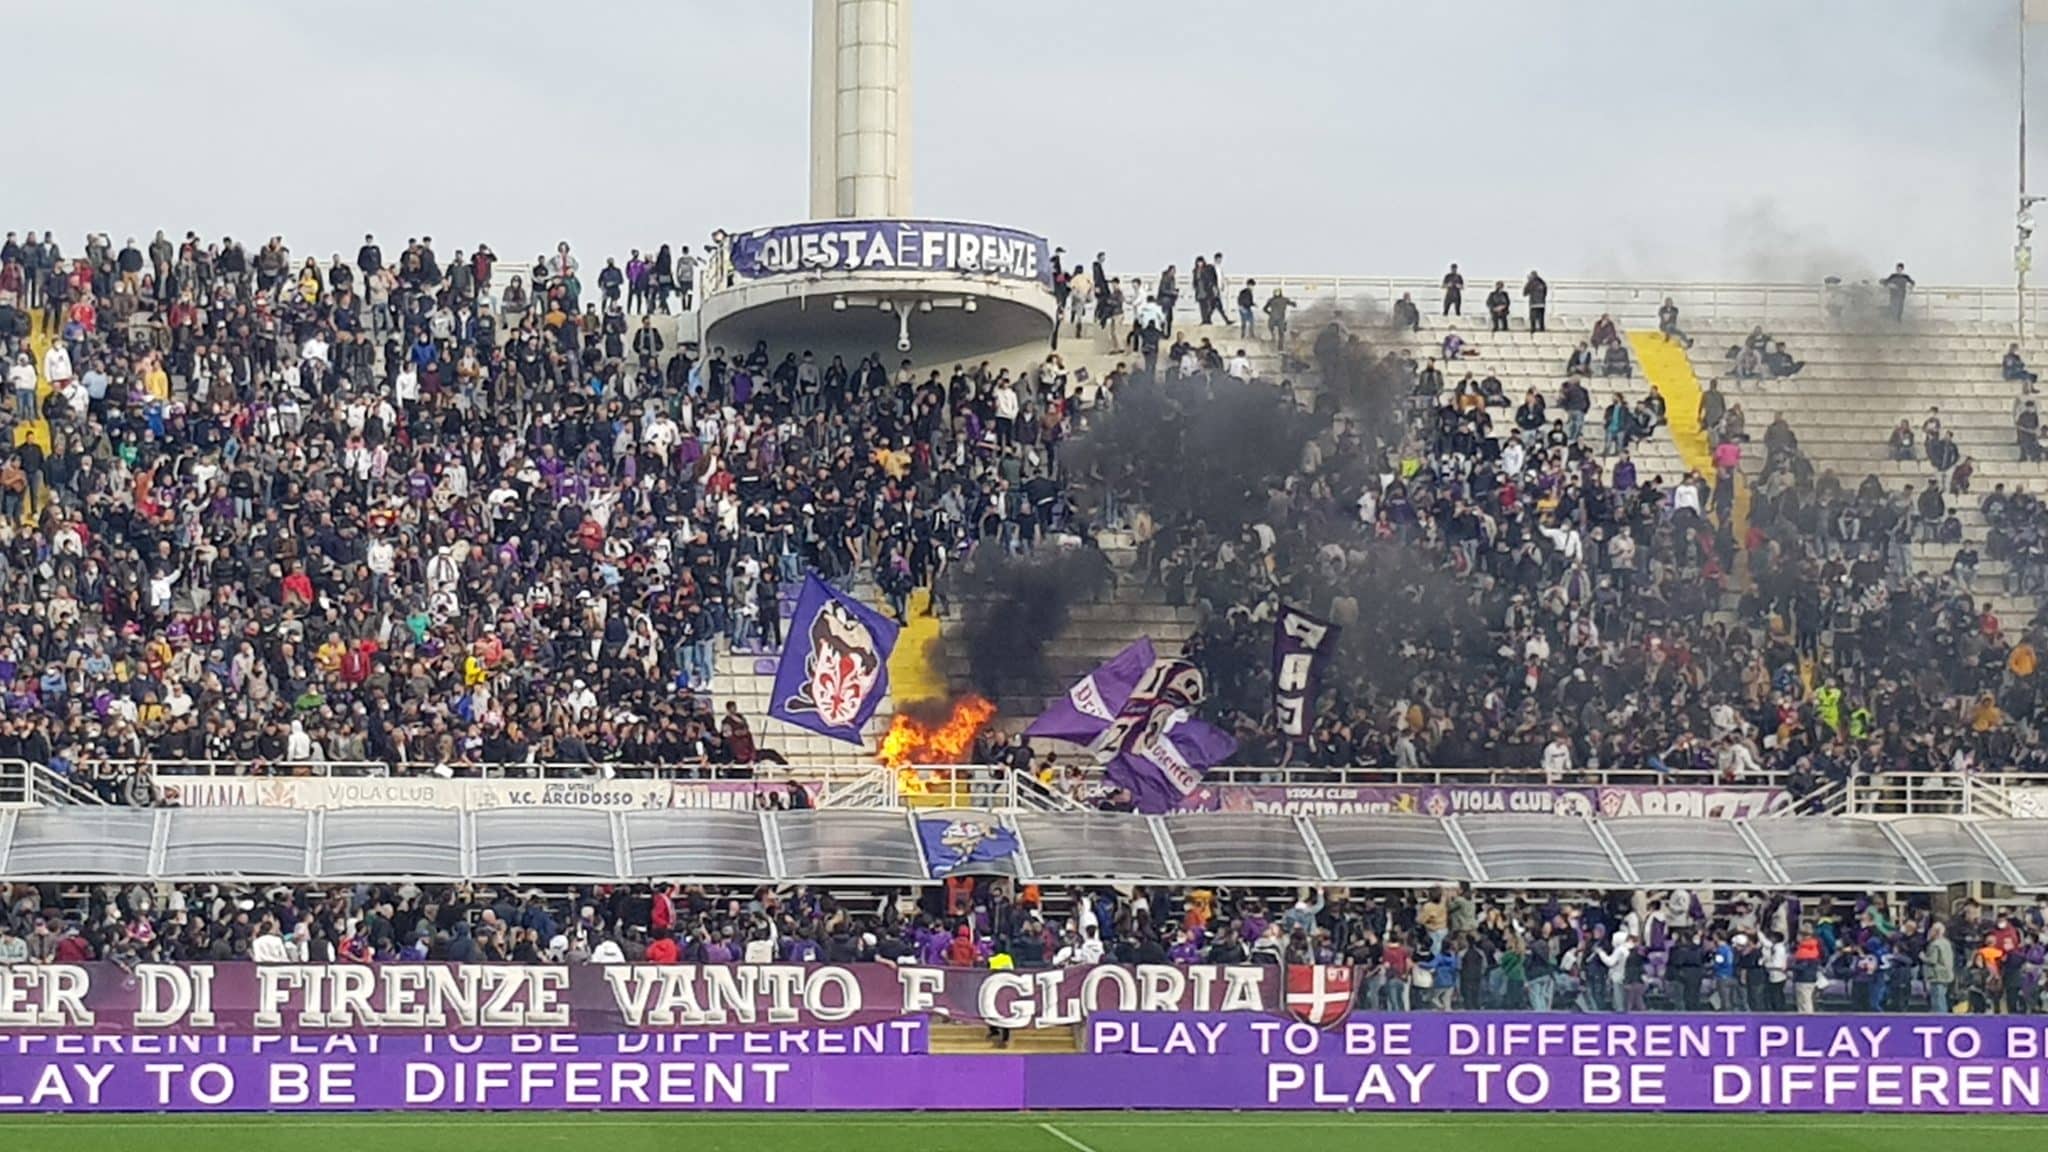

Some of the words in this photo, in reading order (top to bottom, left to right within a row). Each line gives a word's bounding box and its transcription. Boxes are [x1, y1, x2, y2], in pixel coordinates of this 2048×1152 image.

[762, 231, 894, 271] QUESTA
[923, 231, 1037, 278] FIRENZE
[328, 785, 382, 801] VIOLA
[385, 786, 434, 801] CLUB
[541, 791, 633, 805] ARCIDOSSO
[1451, 790, 1505, 810] VIOLA
[1509, 791, 1553, 810] CLUB
[134, 964, 215, 1027] DI
[254, 964, 570, 1028] FIRENZE
[603, 964, 862, 1025] VANTO
[978, 963, 1265, 1029] GLORIA
[1093, 1021, 1228, 1055] PLAY
[1250, 1022, 1320, 1056] TO
[1345, 1023, 1412, 1056] BE
[1448, 1023, 1747, 1057] DIFFERENT
[1759, 1024, 1892, 1058] PLAY
[1912, 1026, 1982, 1059] TO
[2006, 1026, 2048, 1059] B
[144, 1062, 235, 1105] TO
[269, 1062, 356, 1104] BE
[405, 1062, 790, 1104] DIFFERENT
[1267, 1062, 1437, 1104] PLAY
[1463, 1062, 1550, 1105] TO
[1582, 1063, 1667, 1105] BE
[1712, 1063, 2048, 1106] DIFFEREN
